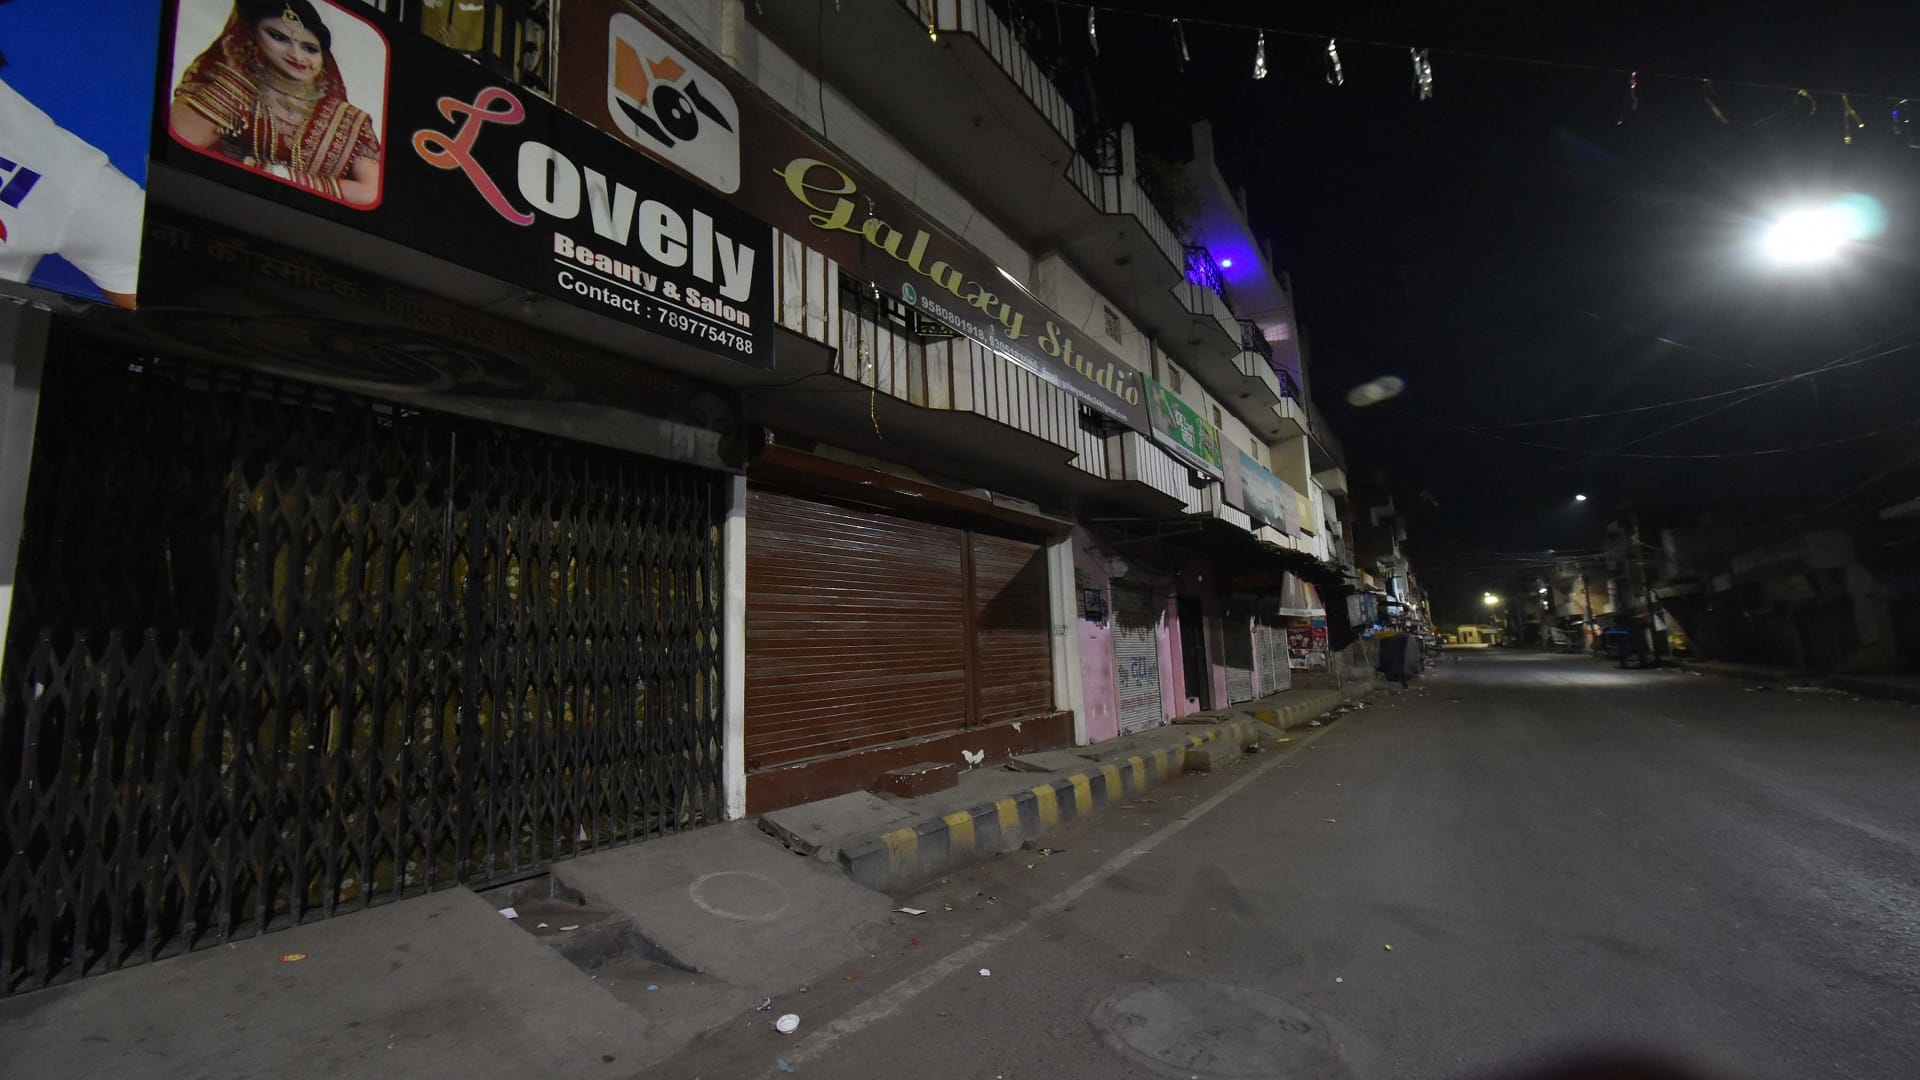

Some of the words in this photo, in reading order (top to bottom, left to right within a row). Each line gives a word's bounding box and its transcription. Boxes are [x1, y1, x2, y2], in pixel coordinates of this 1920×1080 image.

[412, 86, 756, 303] Lovely
[554, 231, 658, 294] Beauty
[662, 280, 681, 302] &
[685, 286, 751, 329] Salon
[557, 270, 641, 316] Contact
[657, 306, 753, 355] 7897754788
[772, 157, 1029, 341] Galaxy
[1037, 320, 1139, 406] Studio
